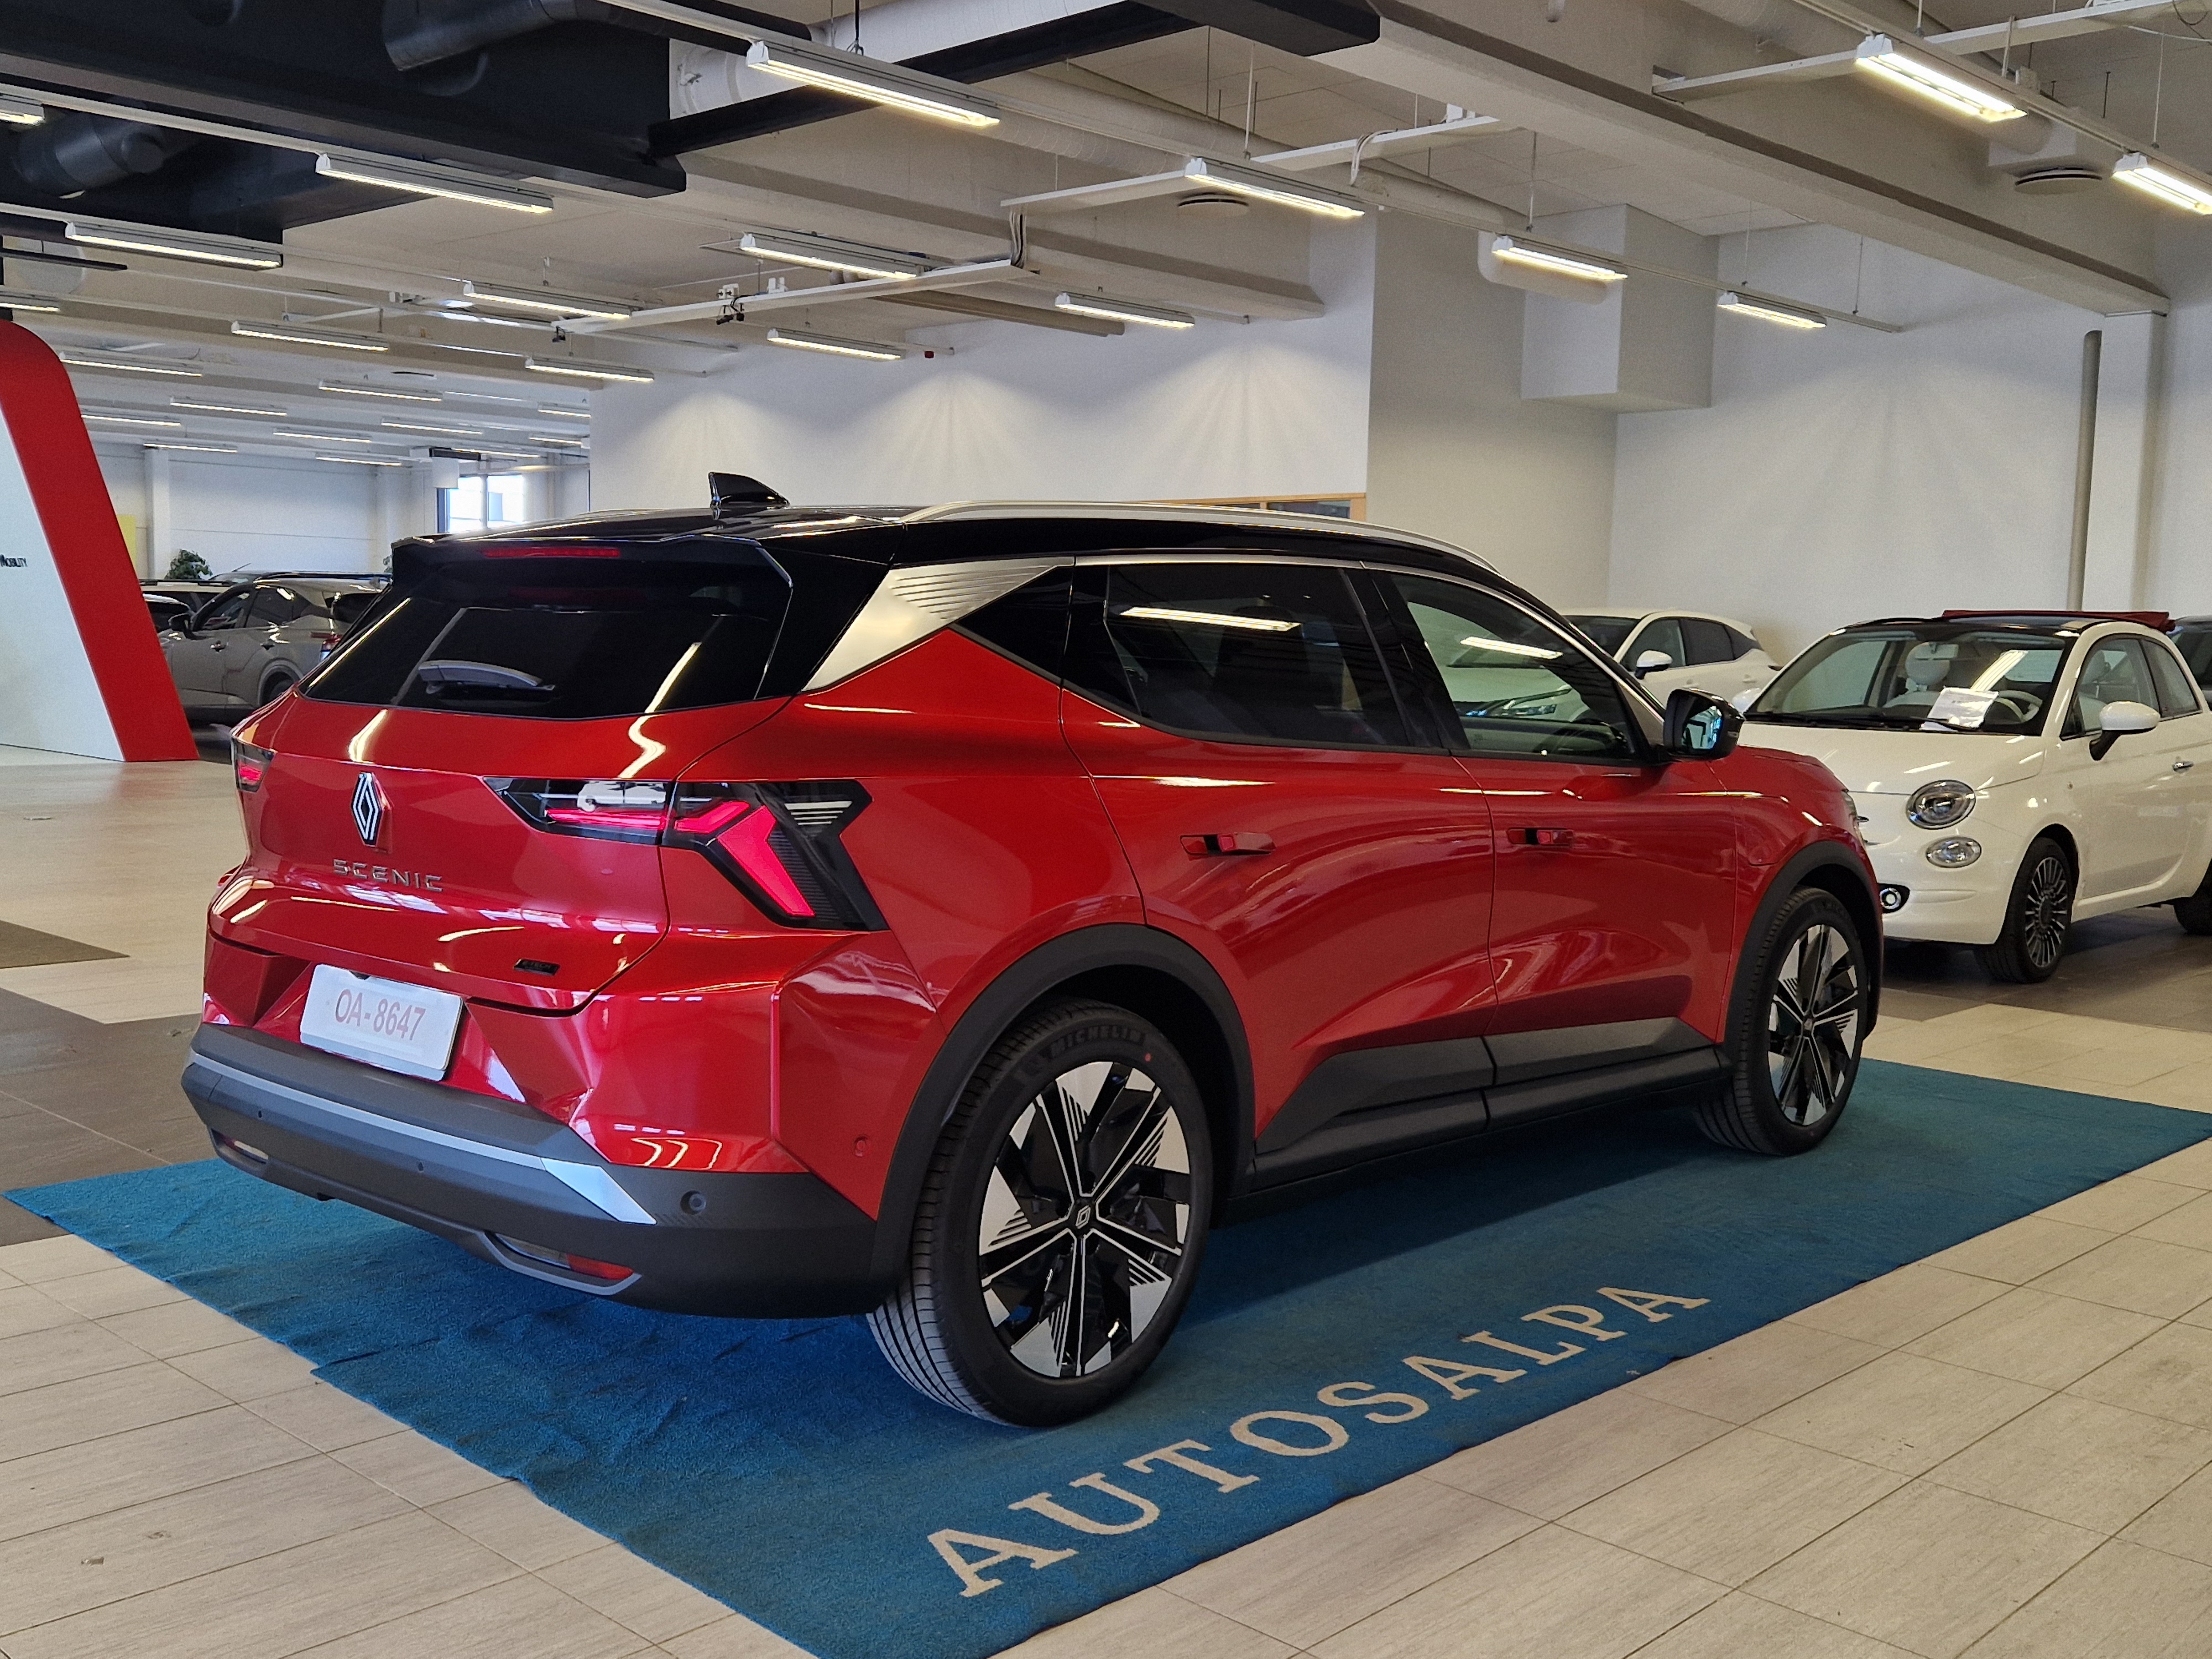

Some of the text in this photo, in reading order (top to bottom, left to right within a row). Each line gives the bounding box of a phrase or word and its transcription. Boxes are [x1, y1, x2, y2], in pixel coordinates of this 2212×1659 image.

[333, 859, 443, 892] SCENIC
[335, 989, 426, 1041] OA-8647
[1051, 1025, 1141, 1057] MICHELIN
[927, 1286, 1712, 1598] AUTOSALPA
